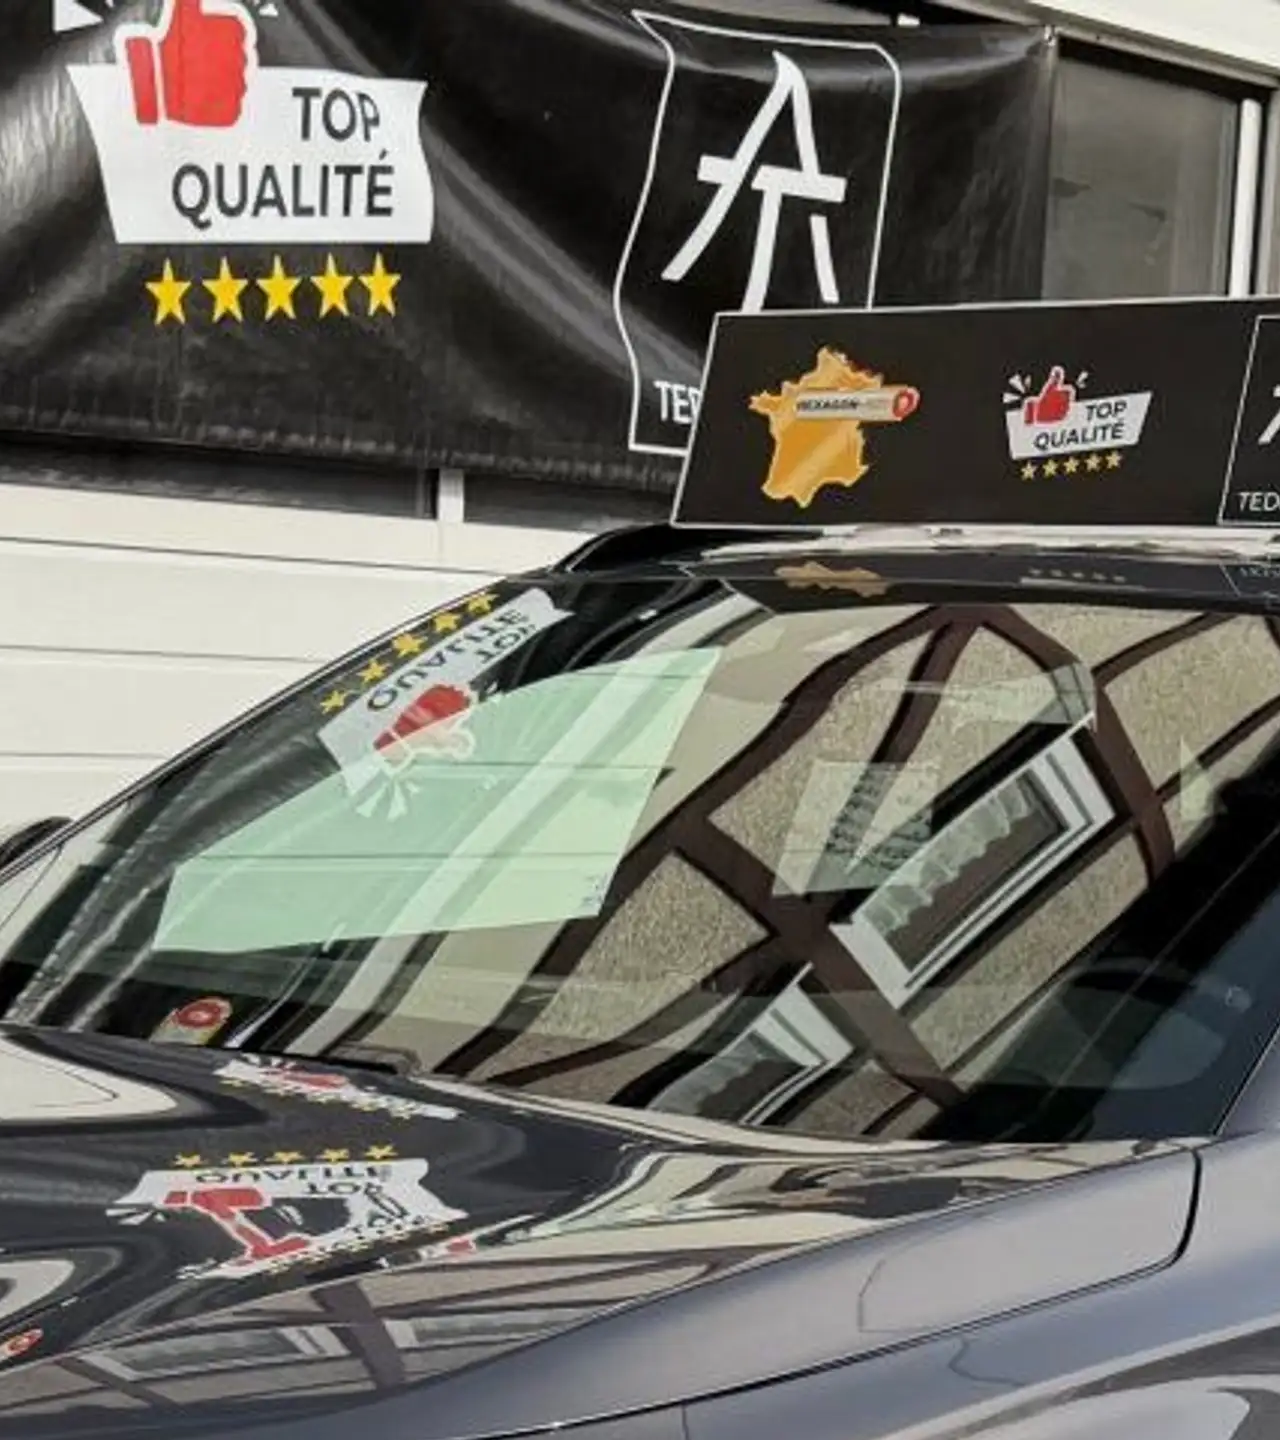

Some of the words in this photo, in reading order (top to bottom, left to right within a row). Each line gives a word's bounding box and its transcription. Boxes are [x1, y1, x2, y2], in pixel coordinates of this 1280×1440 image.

[292, 87, 380, 142] TOP
[172, 148, 394, 229] QUALITÉ
[1086, 401, 1127, 421] TOP
[1034, 420, 1124, 451] QUALITÉ
